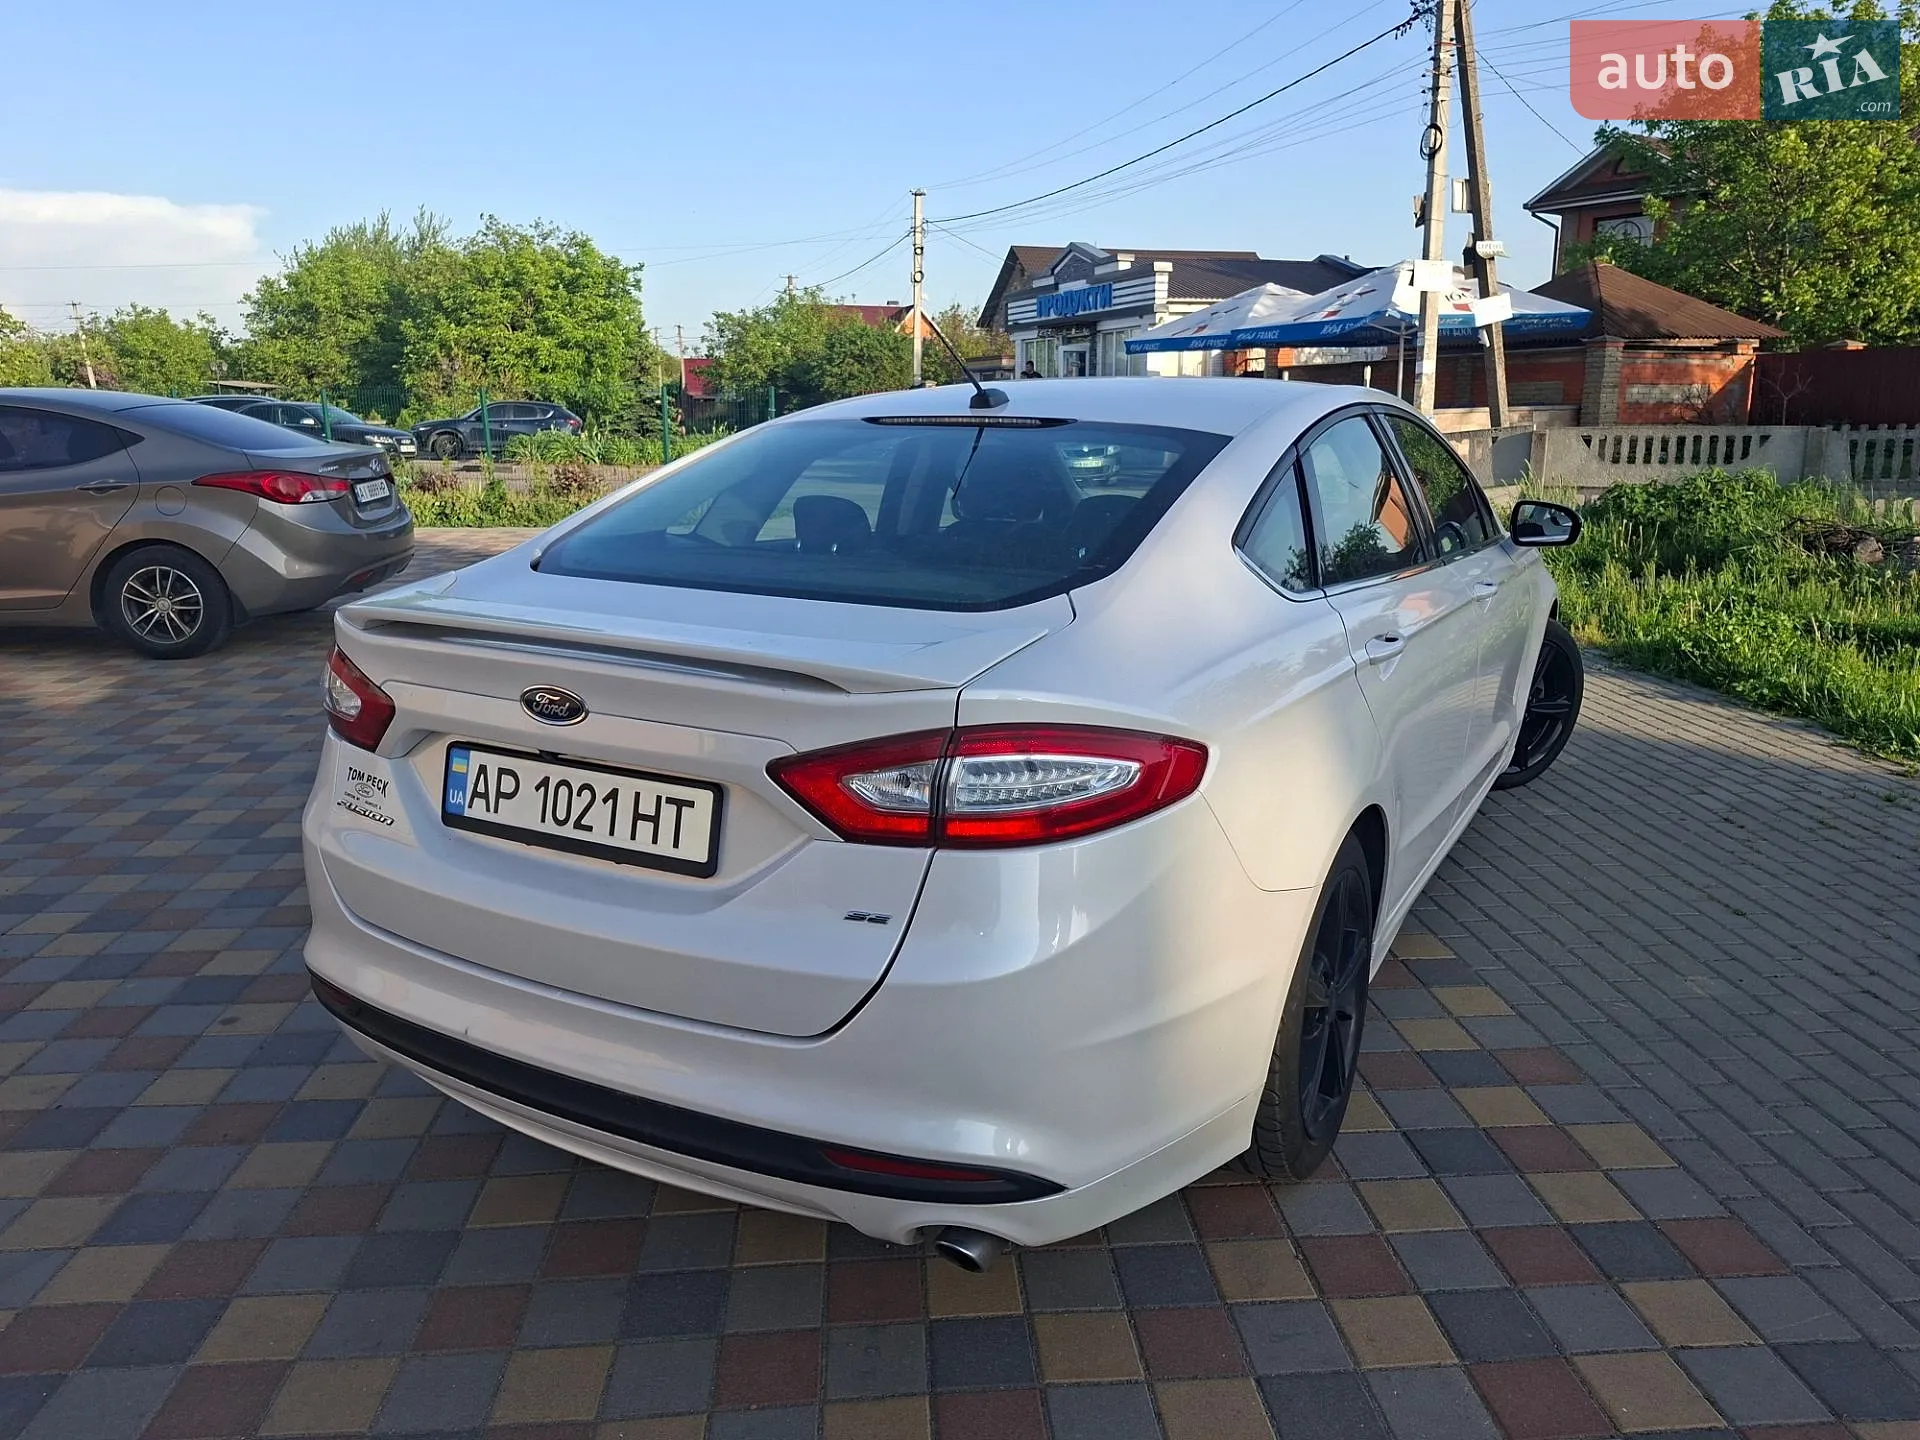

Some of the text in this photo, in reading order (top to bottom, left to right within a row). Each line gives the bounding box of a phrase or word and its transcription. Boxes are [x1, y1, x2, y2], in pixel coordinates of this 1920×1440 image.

[1036, 282, 1113, 318] ПРОДУКТИ
[532, 693, 570, 718] Ford
[347, 766, 366, 782] TOM
[366, 774, 390, 798] PECK
[449, 764, 695, 849] UA AP 1021 HT
[844, 910, 892, 925] SE
